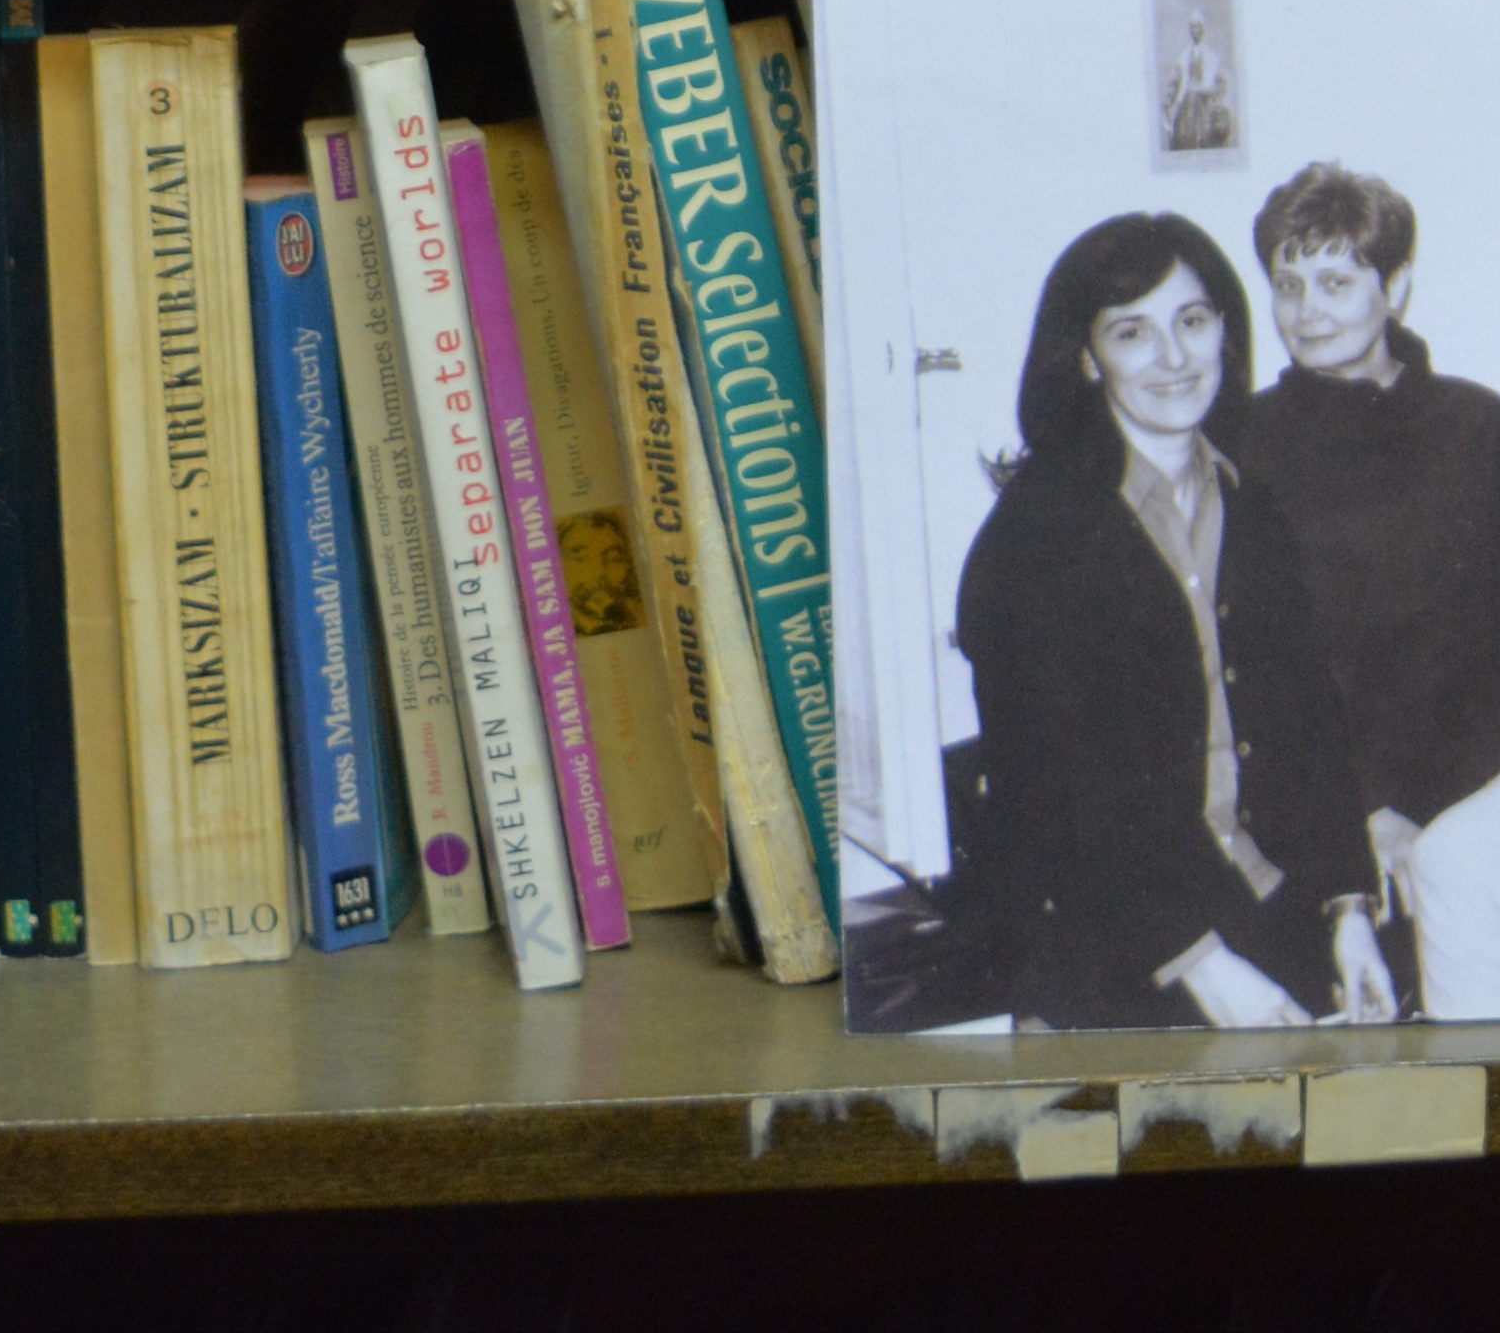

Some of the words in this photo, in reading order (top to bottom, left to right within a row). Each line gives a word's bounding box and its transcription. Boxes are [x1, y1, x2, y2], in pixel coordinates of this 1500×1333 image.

[148, 86, 173, 118] 3
[332, 136, 354, 195] Histoire
[393, 113, 452, 293] worlds
[599, 79, 650, 295] Françaises
[355, 214, 386, 304] science
[145, 141, 213, 493] STRUKTURALIZAM
[365, 304, 391, 337] de
[293, 325, 331, 465] Wycherly
[371, 339, 411, 444] hommes
[632, 316, 685, 536] Civilisation
[684, 229, 818, 569] Selections
[388, 447, 415, 491] aux
[433, 328, 500, 569] separate
[502, 415, 537, 486] JUAN
[390, 493, 436, 631] humanistes
[513, 497, 551, 551] DON
[528, 558, 565, 618] SAM
[664, 553, 693, 589] et
[175, 534, 234, 769] MARKSIZAM
[407, 634, 445, 684] Des
[451, 555, 502, 694] MALIQI
[544, 623, 580, 659] JA
[425, 680, 450, 707] 3.
[550, 658, 586, 749] MAMA,
[331, 752, 362, 827] Ross
[480, 717, 541, 904] SHKËLZEN
[568, 754, 608, 864] manojlović
[334, 875, 372, 910] 1631
